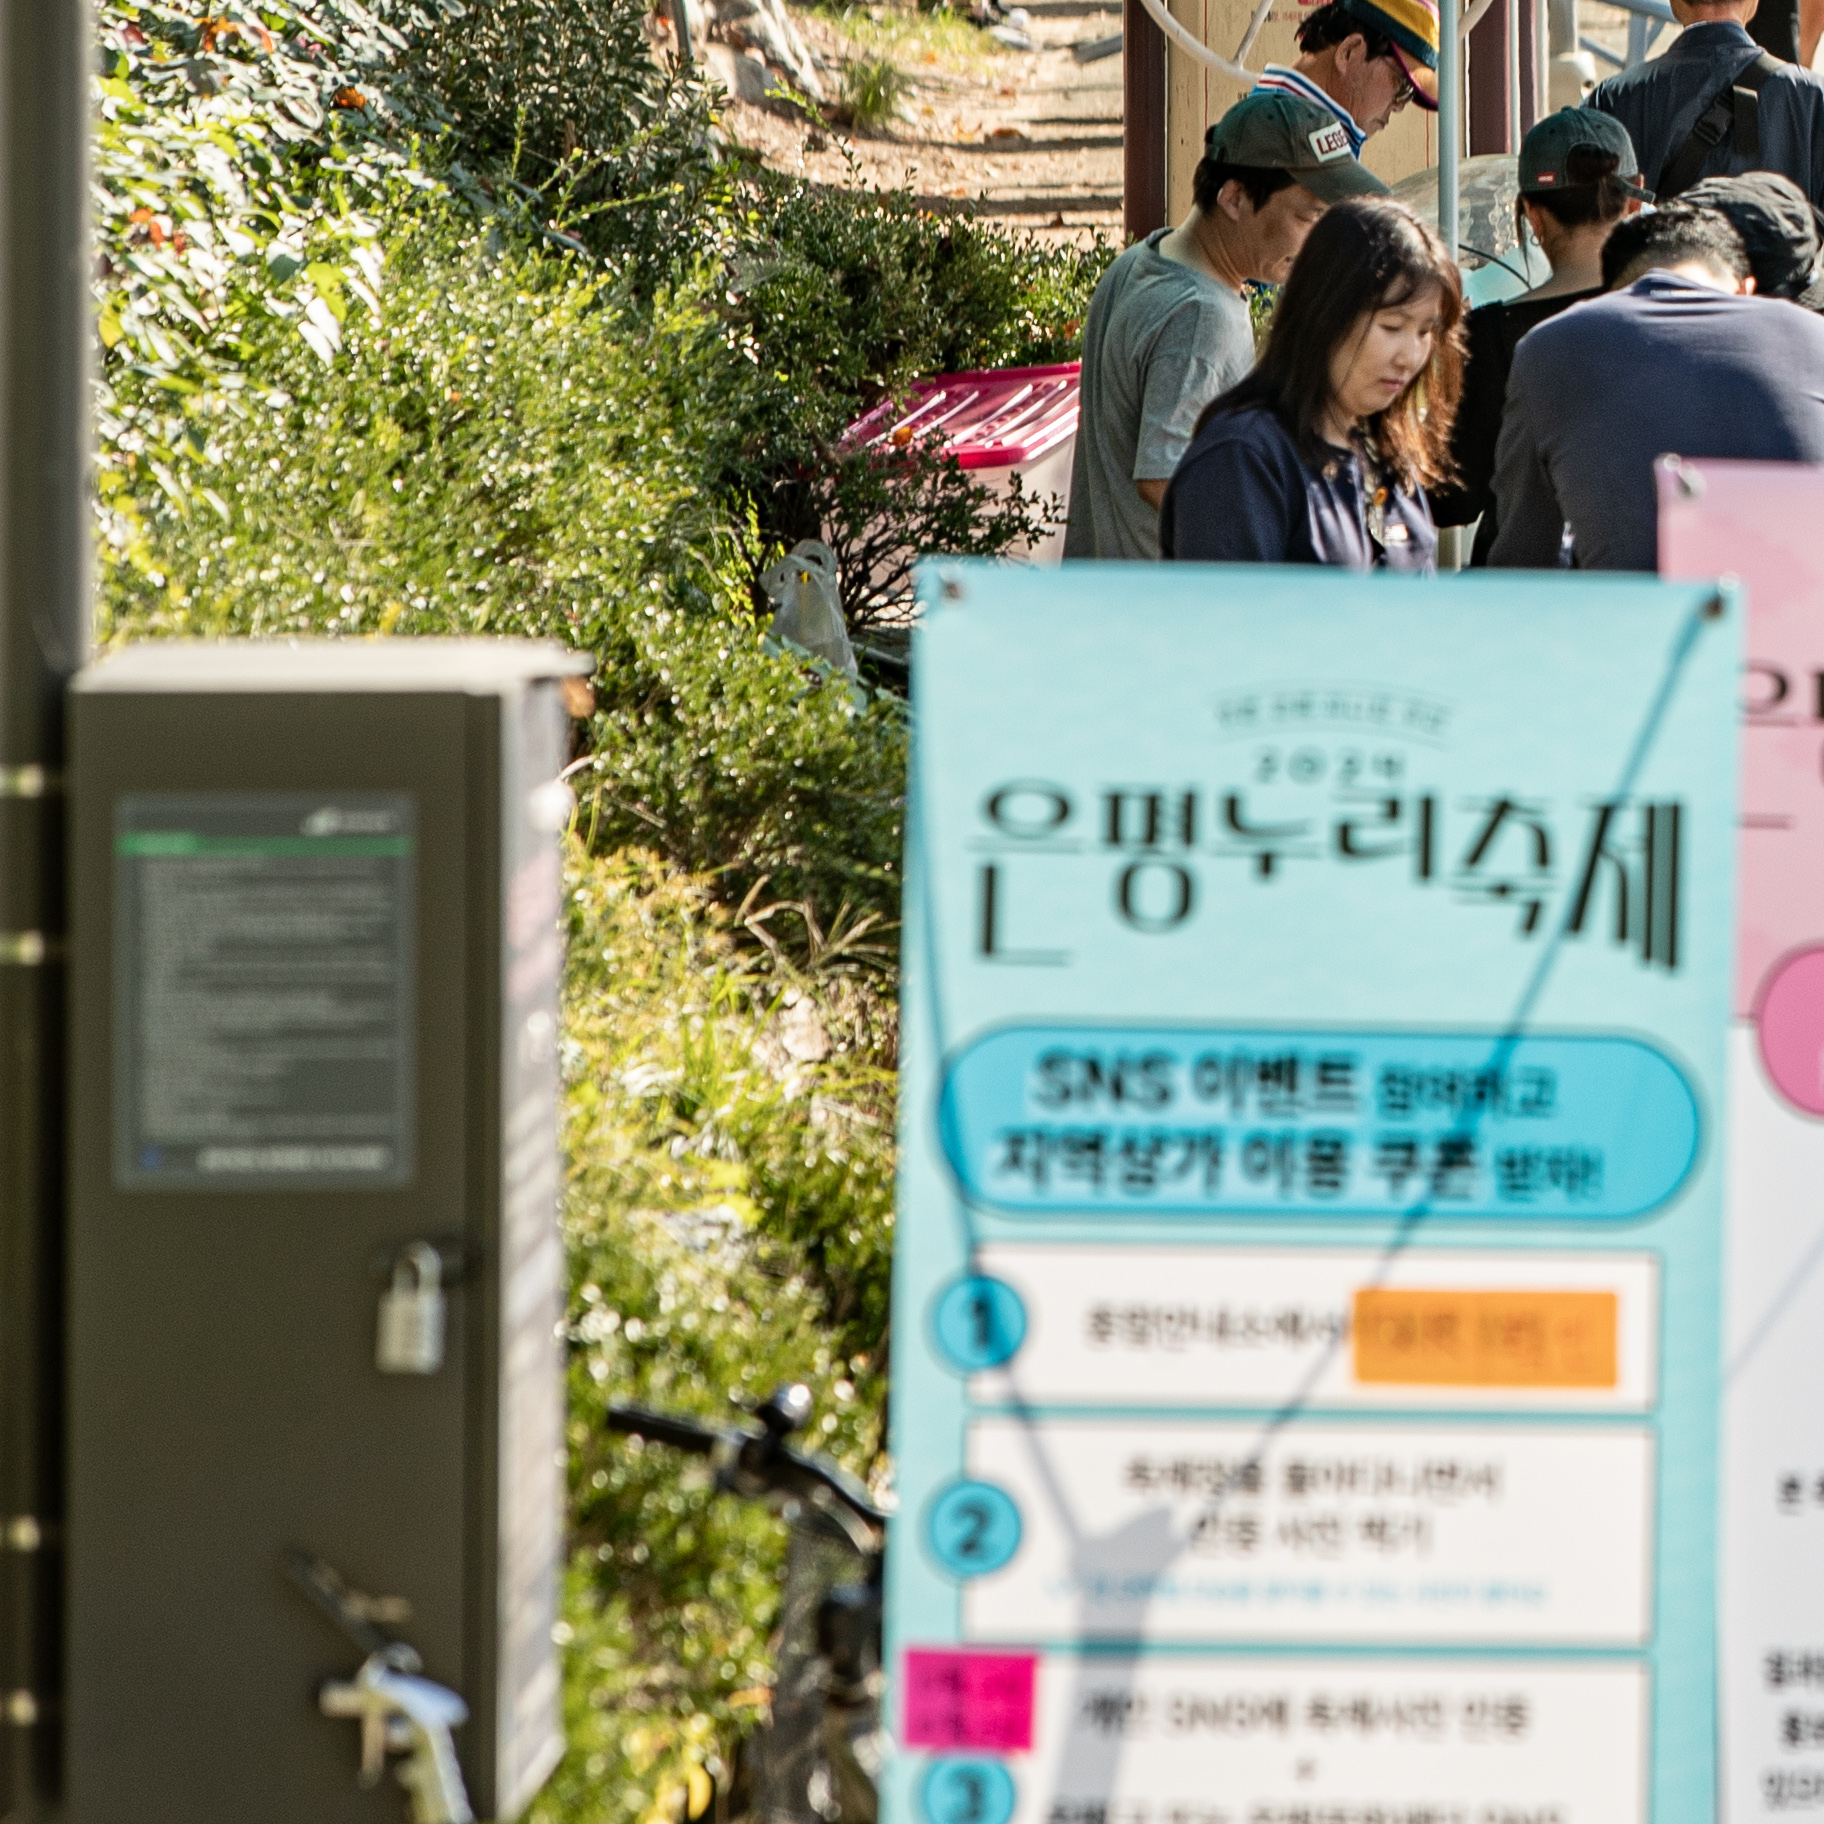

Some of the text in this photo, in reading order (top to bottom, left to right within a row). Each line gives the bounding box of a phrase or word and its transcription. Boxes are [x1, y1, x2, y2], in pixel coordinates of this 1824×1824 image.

[966, 778, 1685, 974] 은평누리축제
[1032, 1044, 1176, 1116] SNS
[1191, 1046, 1362, 1119] 이벤트
[1240, 1126, 1350, 1198] 이용
[952, 1501, 994, 1559] 2
